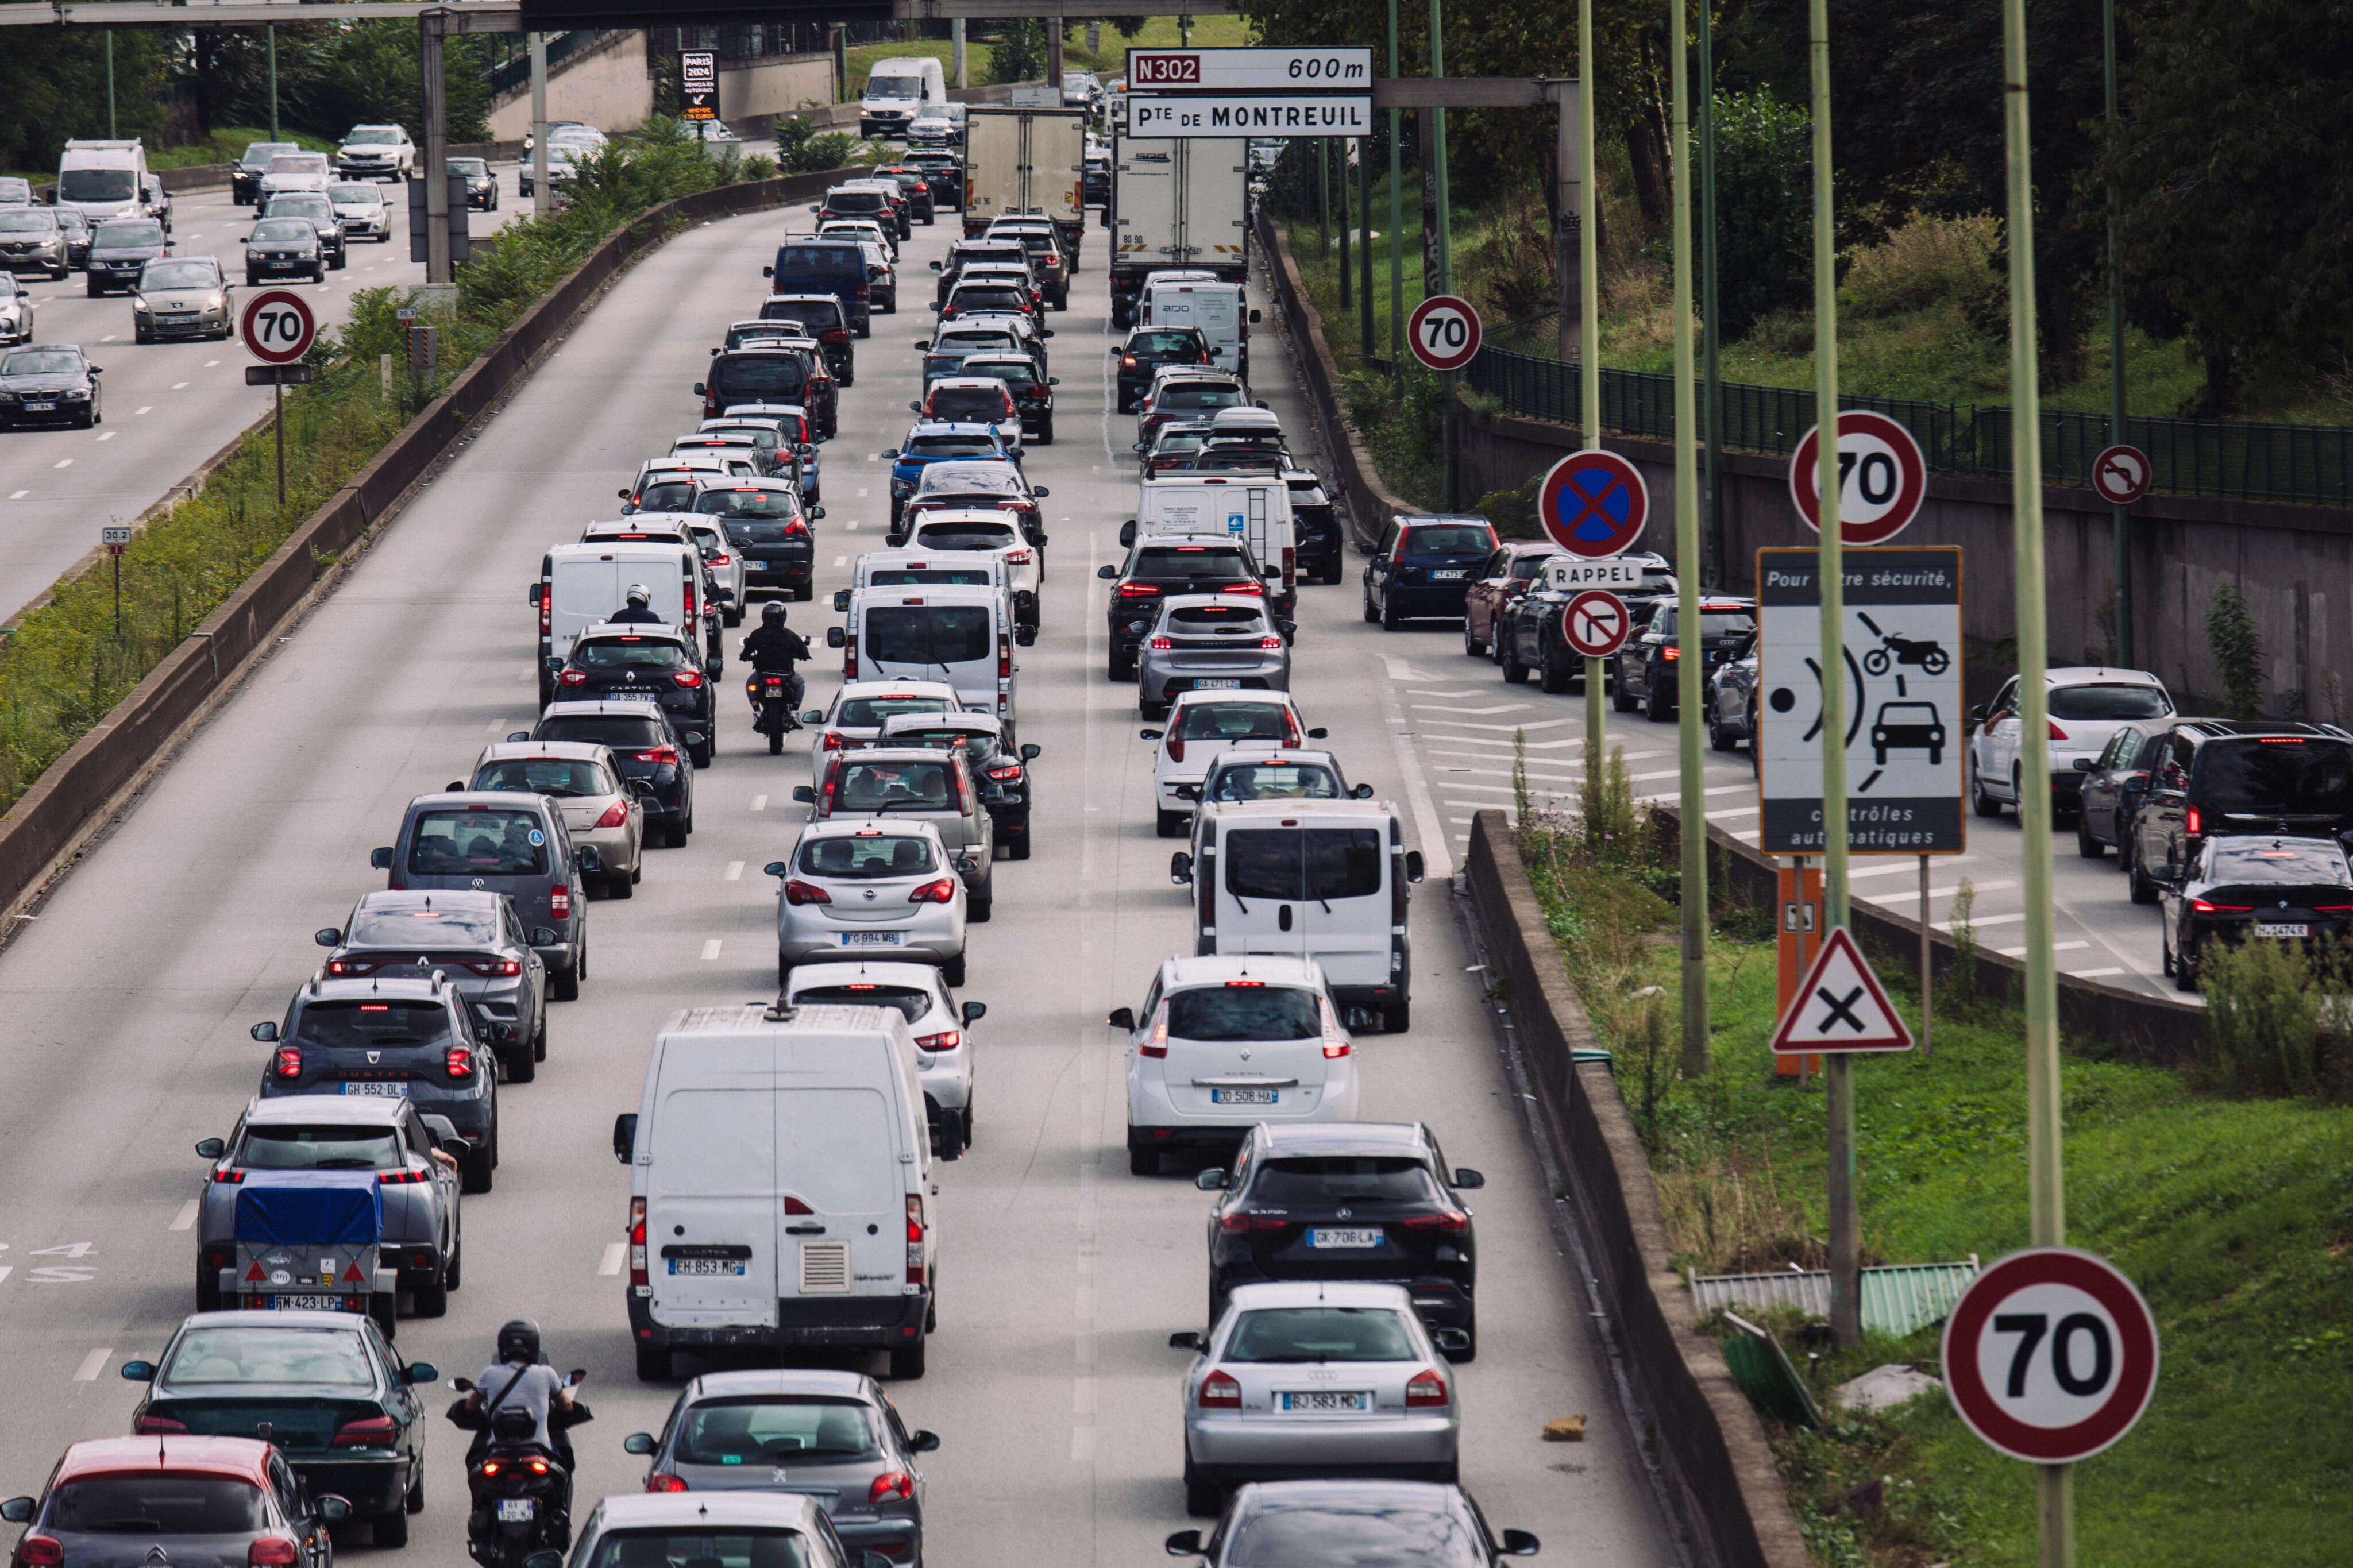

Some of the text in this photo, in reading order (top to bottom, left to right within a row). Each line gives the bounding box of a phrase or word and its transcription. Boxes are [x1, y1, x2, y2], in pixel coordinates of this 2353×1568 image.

[686, 57, 711, 65] PARIS
[1139, 59, 1196, 79] N302
[687, 68, 710, 76] 2024
[1181, 114, 1201, 126] DE
[1212, 107, 1361, 126] MONTREUIL
[1124, 235, 1143, 244] 80 90
[259, 311, 300, 342] 70
[1425, 318, 1466, 347] 70
[106, 531, 128, 539] 30.2
[1556, 567, 1634, 582] RAPPEL
[1766, 571, 1952, 588] Pour tre sécurité,
[1811, 805, 1914, 821] ctrôles
[1994, 1312, 2113, 1397] 70
